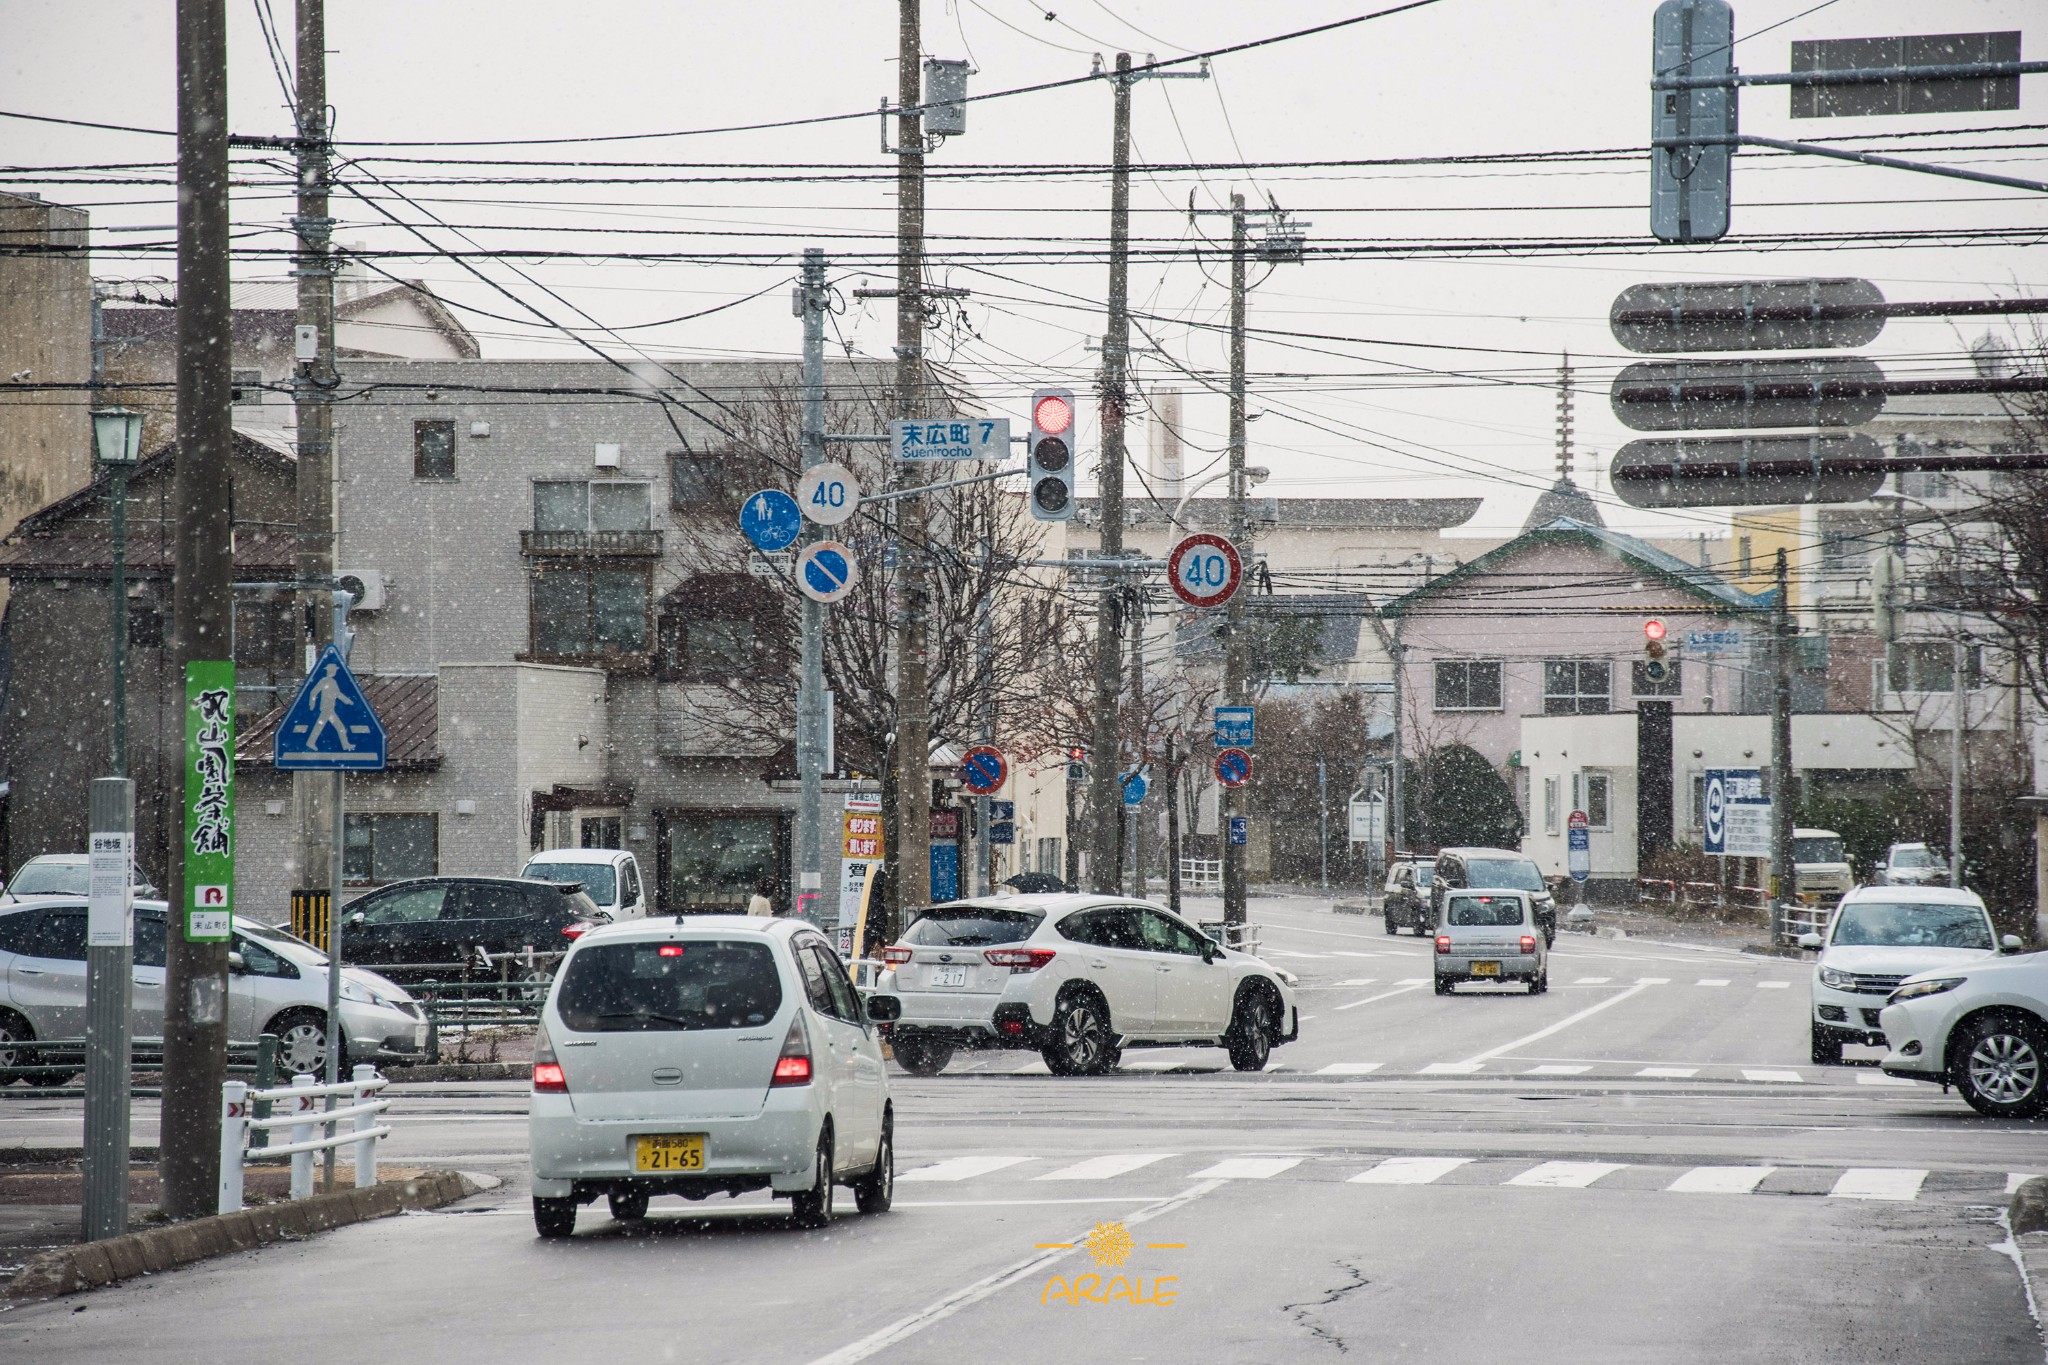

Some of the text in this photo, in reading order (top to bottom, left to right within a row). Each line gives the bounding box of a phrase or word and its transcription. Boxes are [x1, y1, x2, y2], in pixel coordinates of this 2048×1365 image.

[901, 421, 995, 446] 末広町 7
[812, 481, 845, 508] 40
[1185, 554, 1225, 587] 40
[94, 838, 121, 850] 谷地坂
[651, 1149, 700, 1168] 21-65
